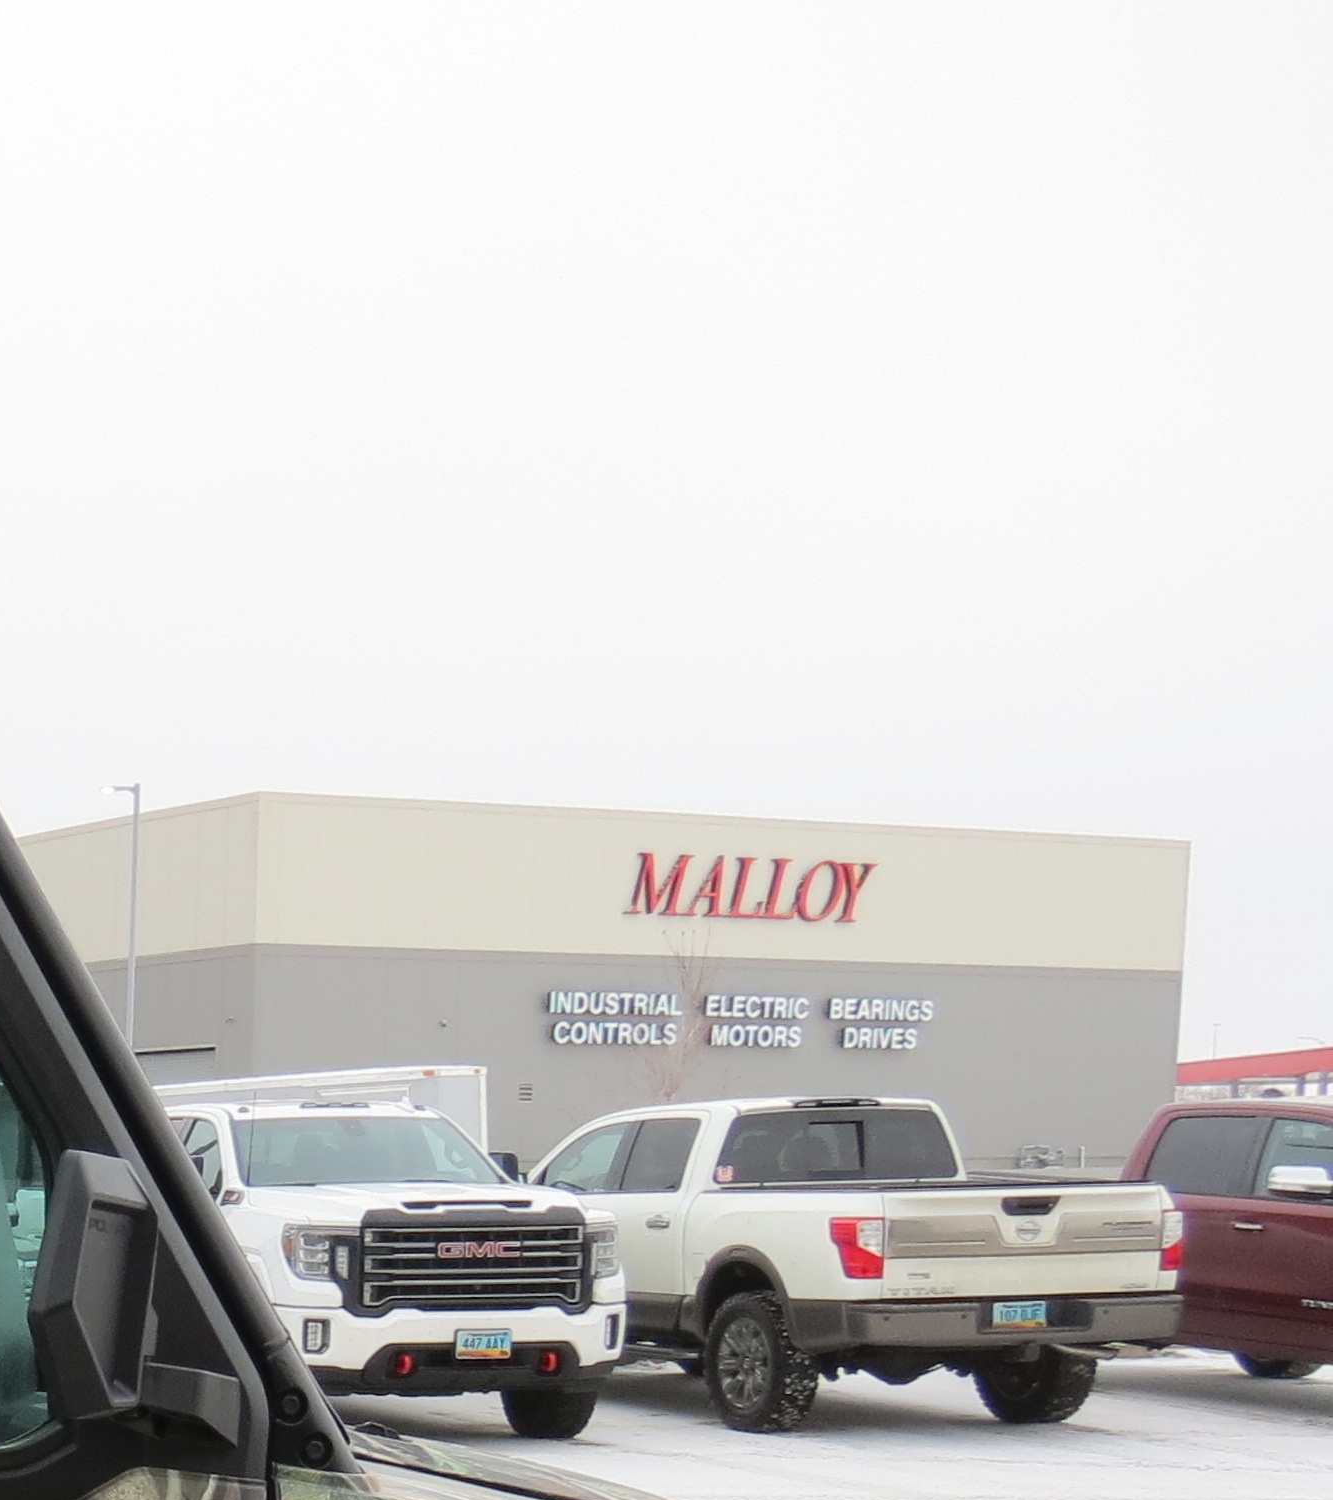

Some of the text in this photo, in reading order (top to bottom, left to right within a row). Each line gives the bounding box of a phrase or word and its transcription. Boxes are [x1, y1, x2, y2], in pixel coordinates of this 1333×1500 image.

[621, 852, 879, 923] MALLOY
[548, 990, 934, 1022] INDUSTRIAL ELECTRIC BEARINGS
[552, 1020, 918, 1050] CONTROLS MOTORS DRIVES
[437, 1241, 521, 1258] GMC
[462, 1337, 483, 1350] 447
